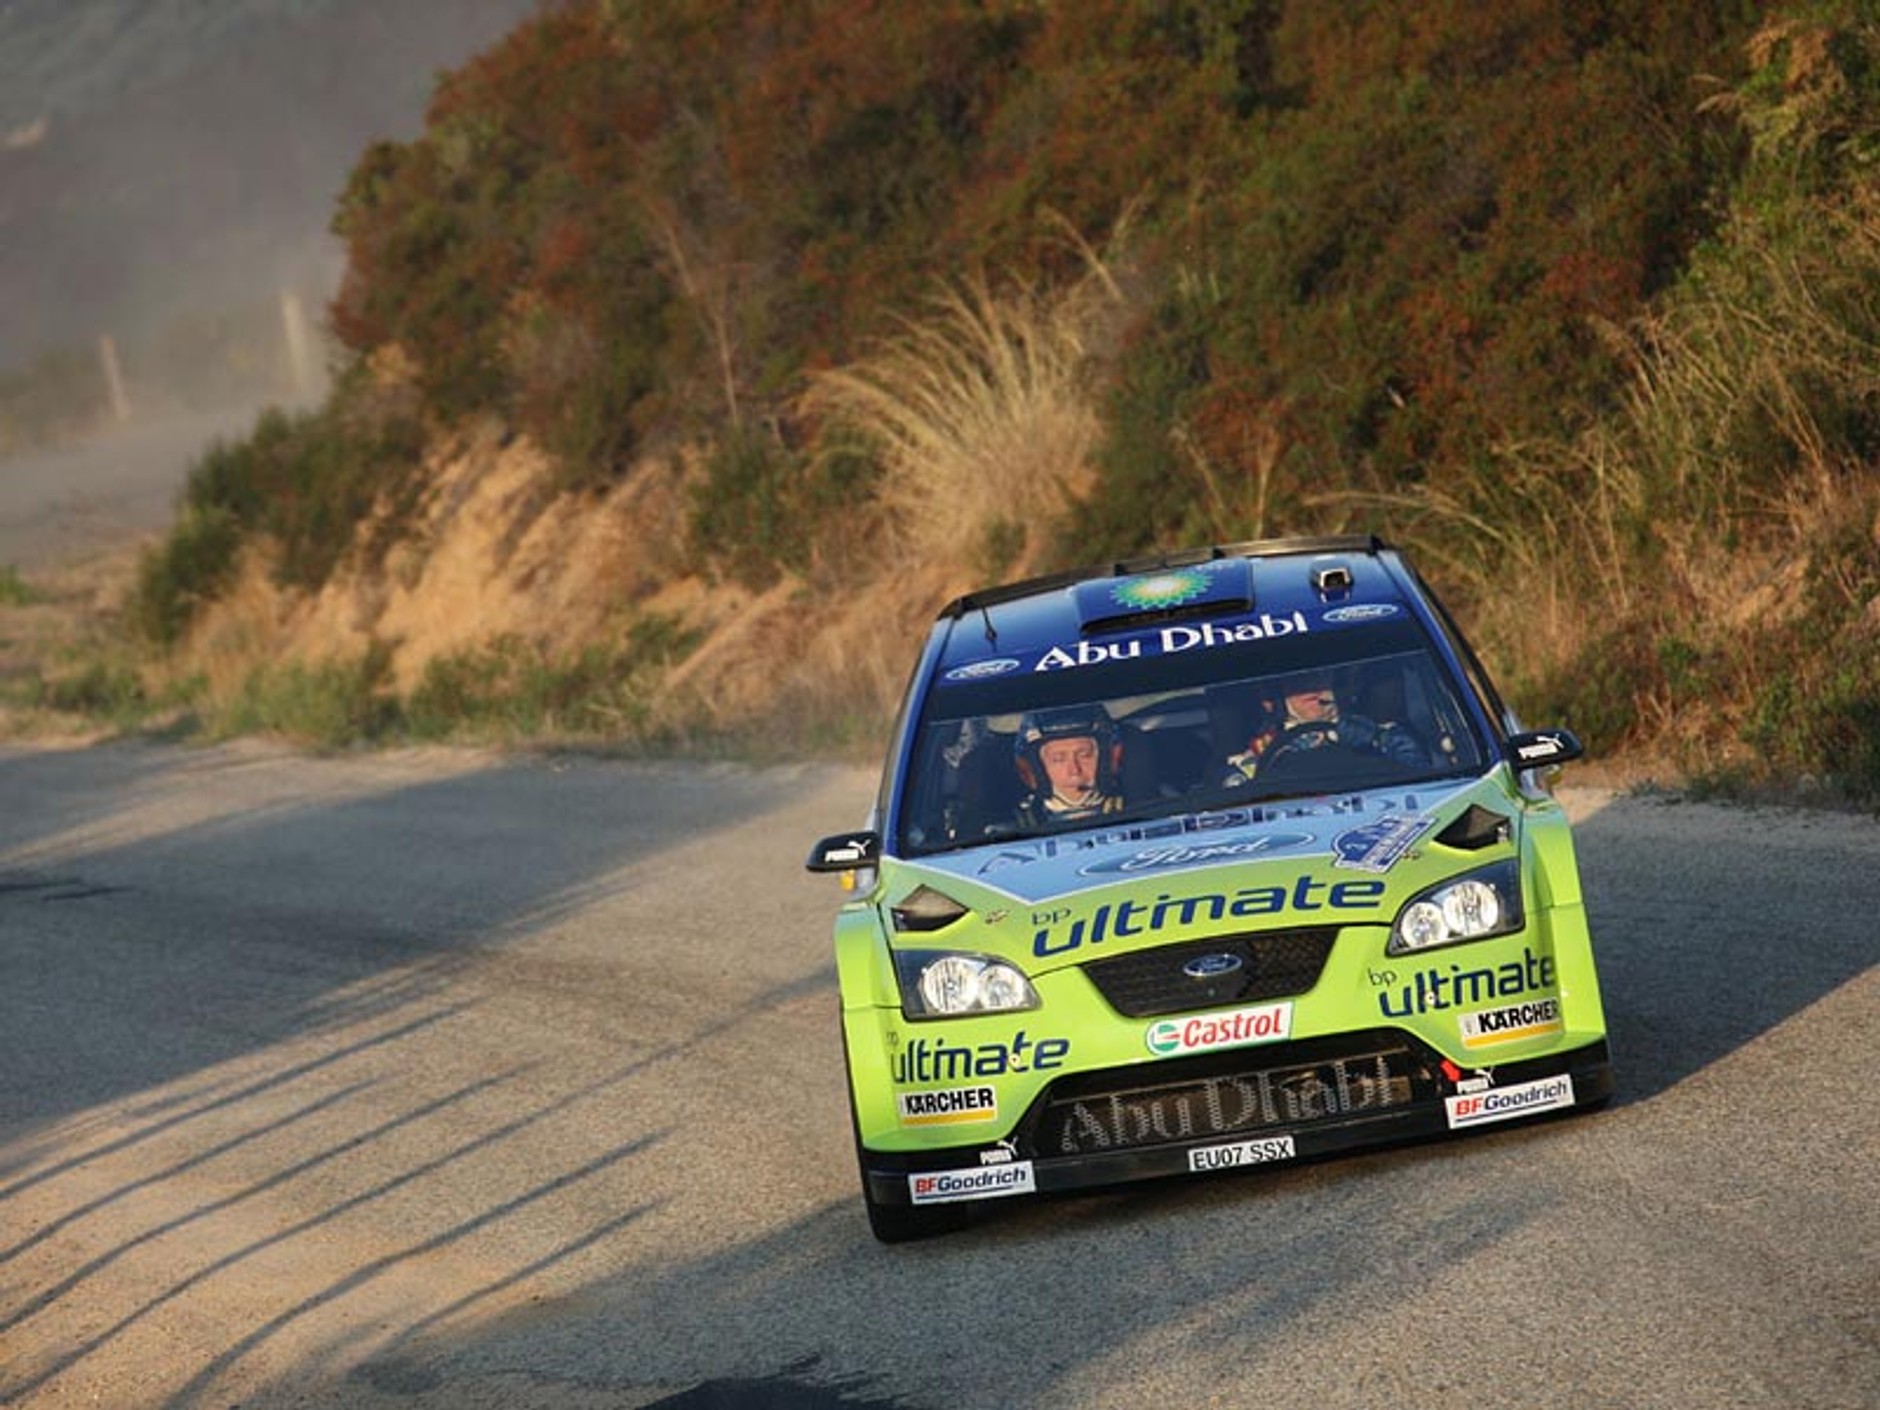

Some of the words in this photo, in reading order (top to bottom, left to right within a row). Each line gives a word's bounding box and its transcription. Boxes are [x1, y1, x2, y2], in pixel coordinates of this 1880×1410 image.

[1034, 642, 1141, 671] Abu
[1160, 611, 1307, 652] Dhabi
[1032, 908, 1071, 926] bp
[1033, 876, 1386, 957] ultimate
[1368, 968, 1397, 987] bp
[1379, 947, 1555, 1017] ultimate
[1183, 1008, 1282, 1047] Castrol
[891, 1031, 1070, 1083] ultimate
[1455, 1080, 1568, 1117] BFGoodrich
[1061, 1092, 1192, 1151] Abu
[1193, 1147, 1243, 1170] EU07
[1249, 1139, 1292, 1163] SSX
[914, 1166, 1027, 1194] BFGoodrich
